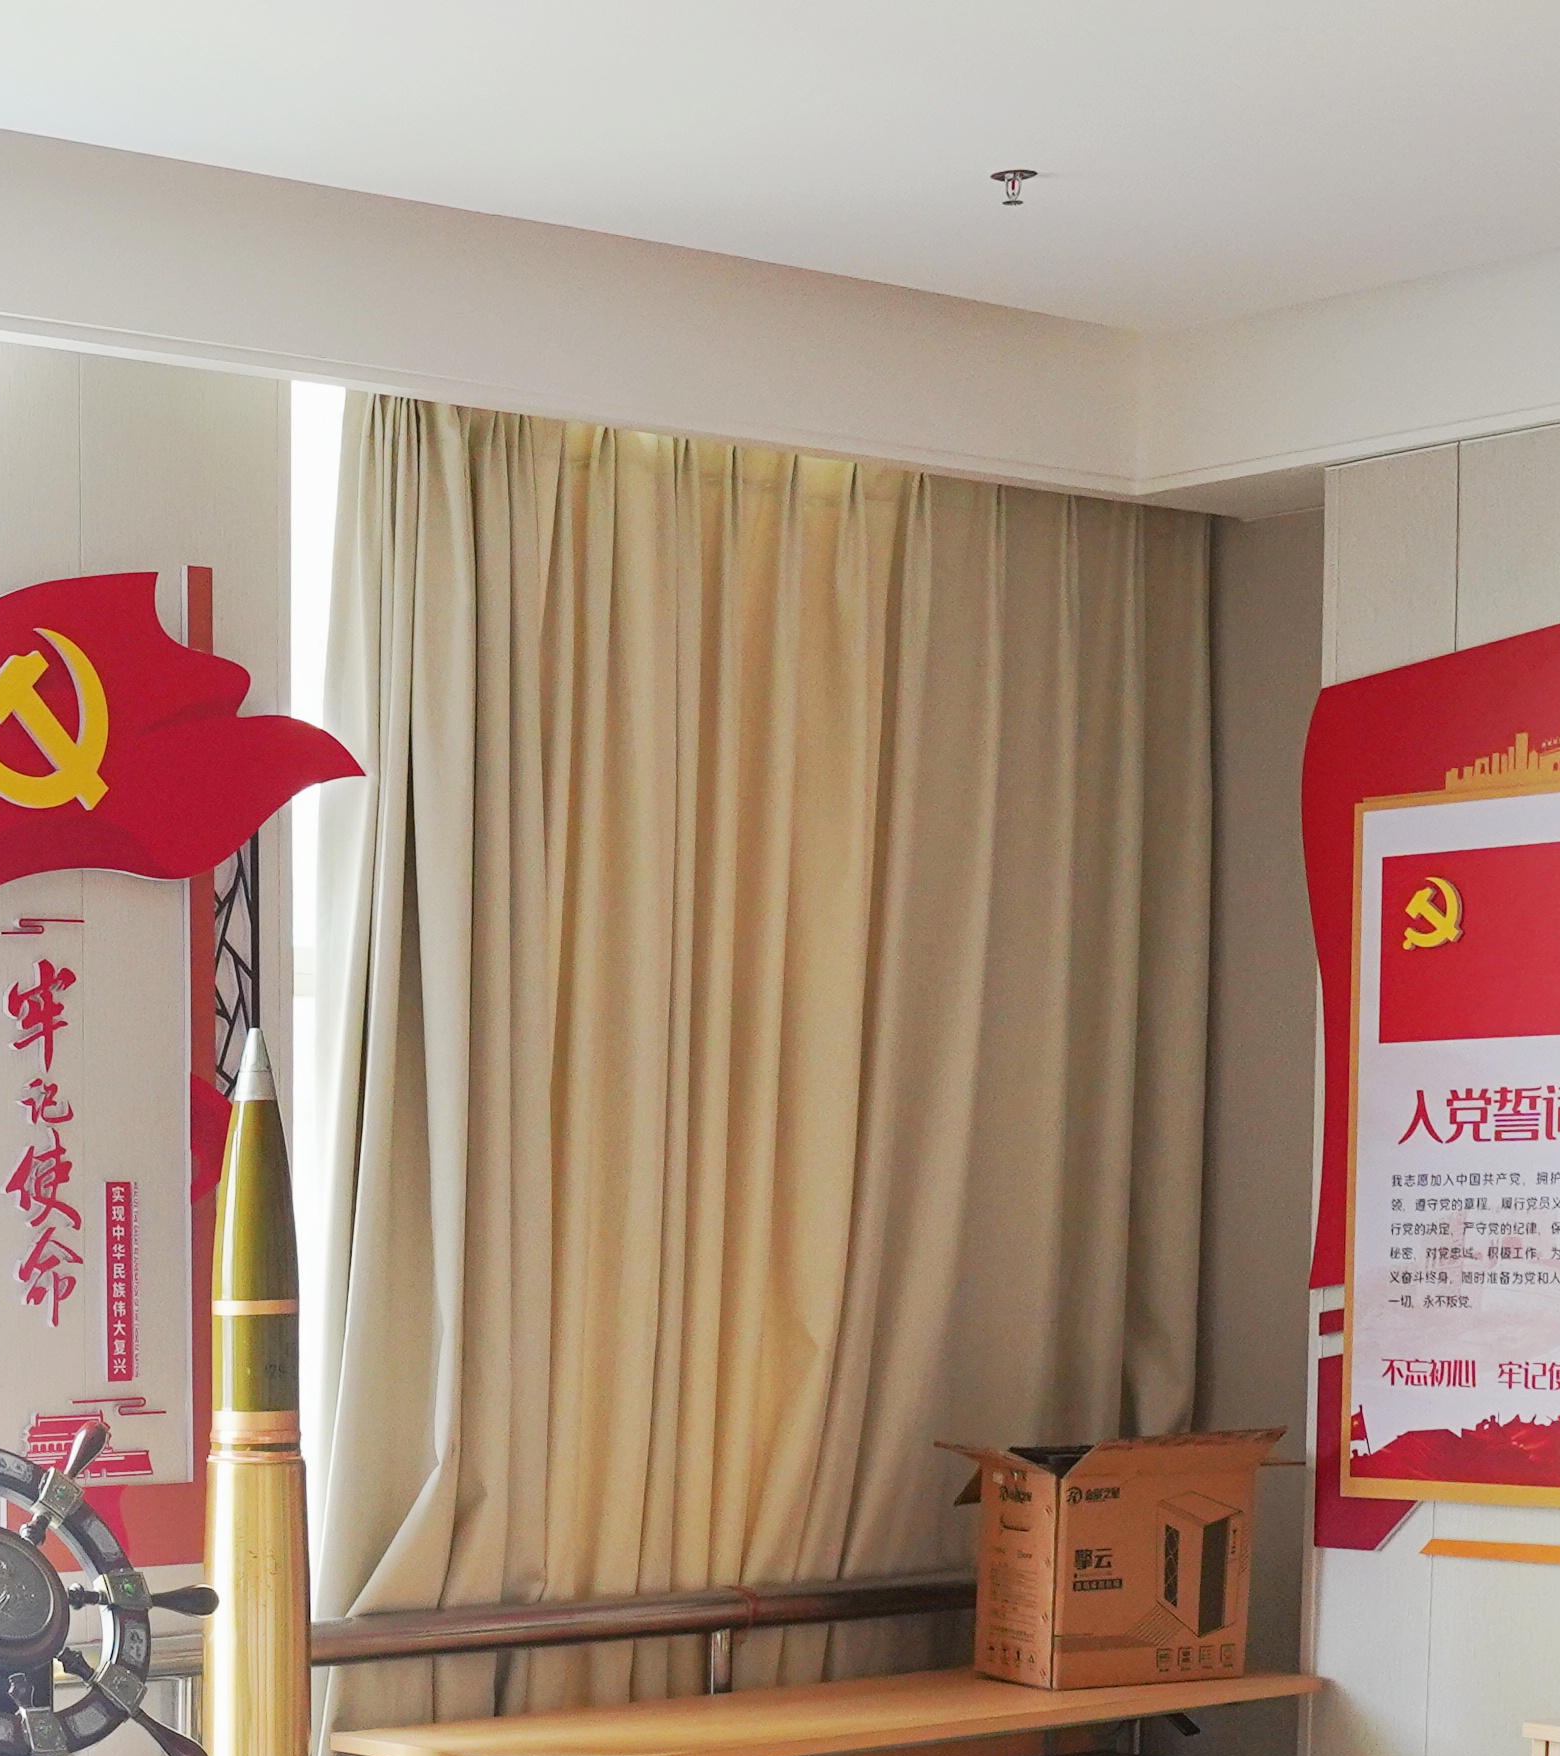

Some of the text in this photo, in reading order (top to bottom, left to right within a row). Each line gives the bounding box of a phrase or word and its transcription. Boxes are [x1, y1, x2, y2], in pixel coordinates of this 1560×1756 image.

[6, 958, 84, 1327] 牢记使命
[111, 1186, 127, 1375] 实现中华民族伟大复兴
[1381, 1358, 1477, 1388] 不忘初心
